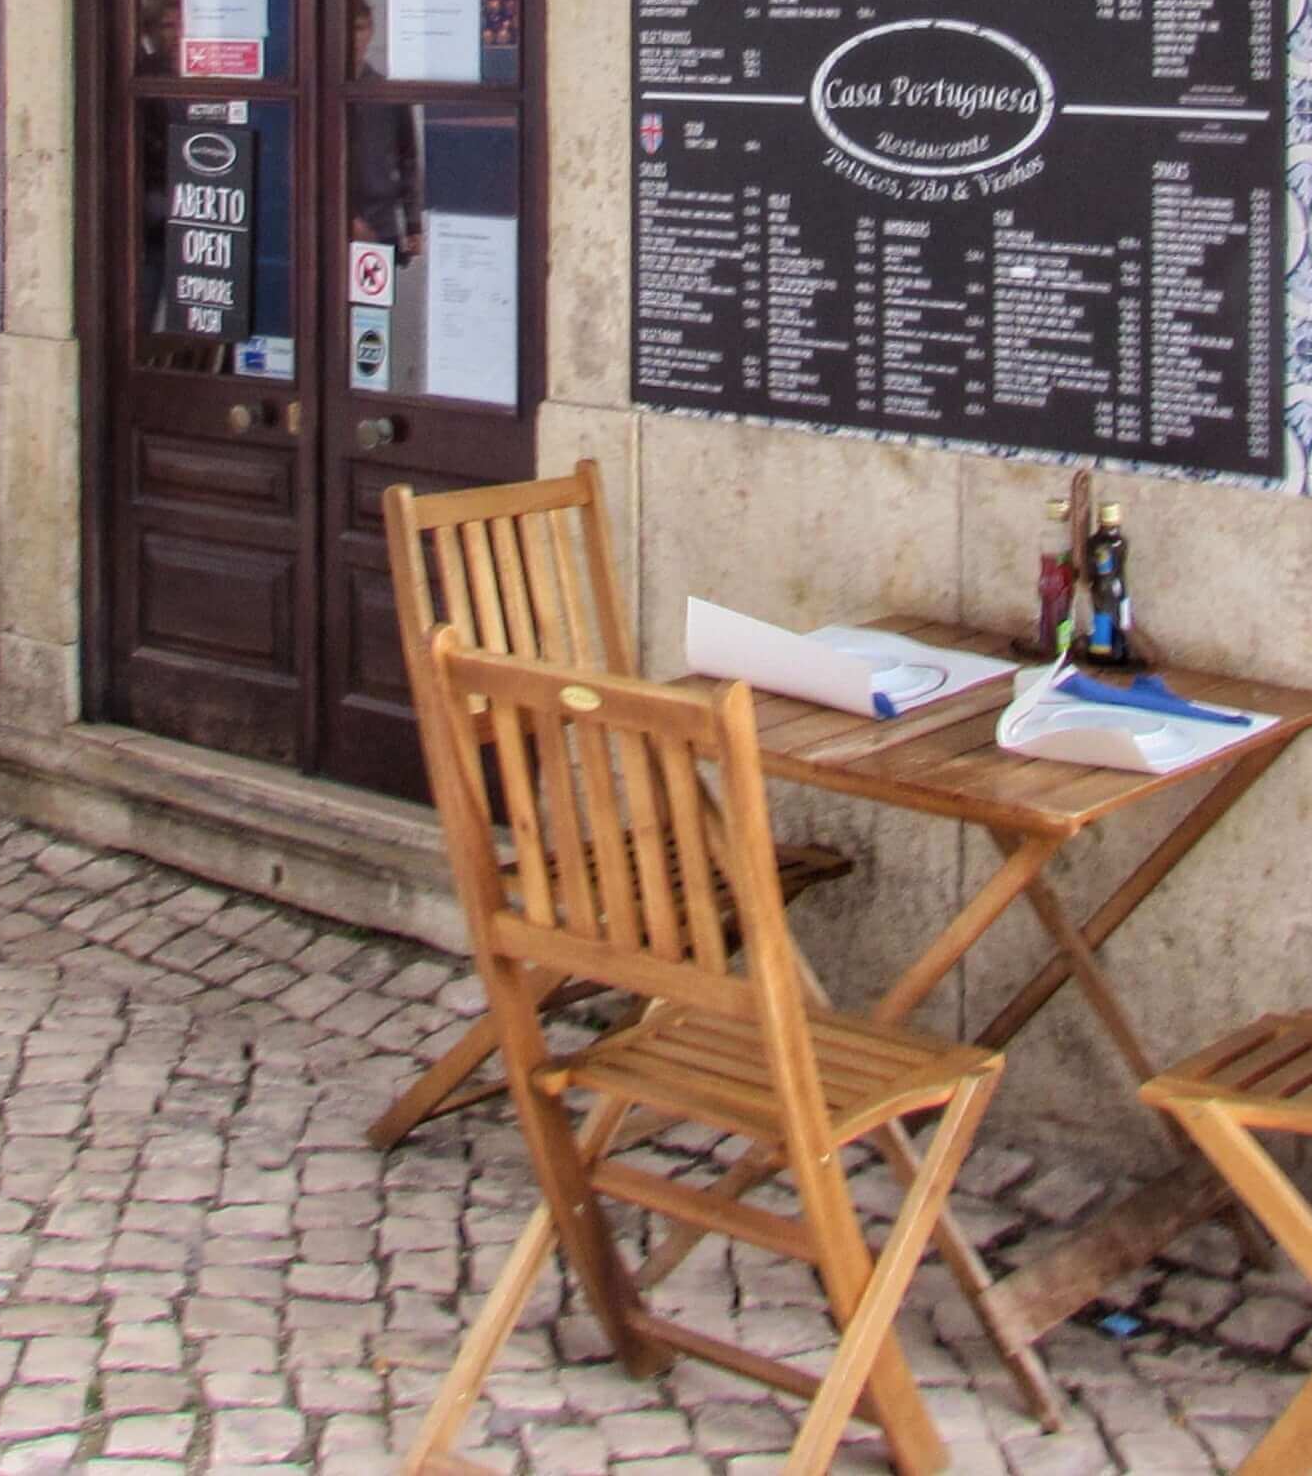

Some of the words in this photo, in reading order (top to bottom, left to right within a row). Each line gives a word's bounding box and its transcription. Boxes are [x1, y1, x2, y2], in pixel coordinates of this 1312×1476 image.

[825, 77, 883, 110] Casa
[889, 75, 1040, 119] Portuguesa
[876, 131, 991, 160] Restaurante
[952, 180, 973, 202] &
[972, 153, 1046, 197] Vinhos
[171, 183, 245, 224] ABERTO
[182, 230, 232, 269] OPEN
[188, 307, 223, 334] PUSH
